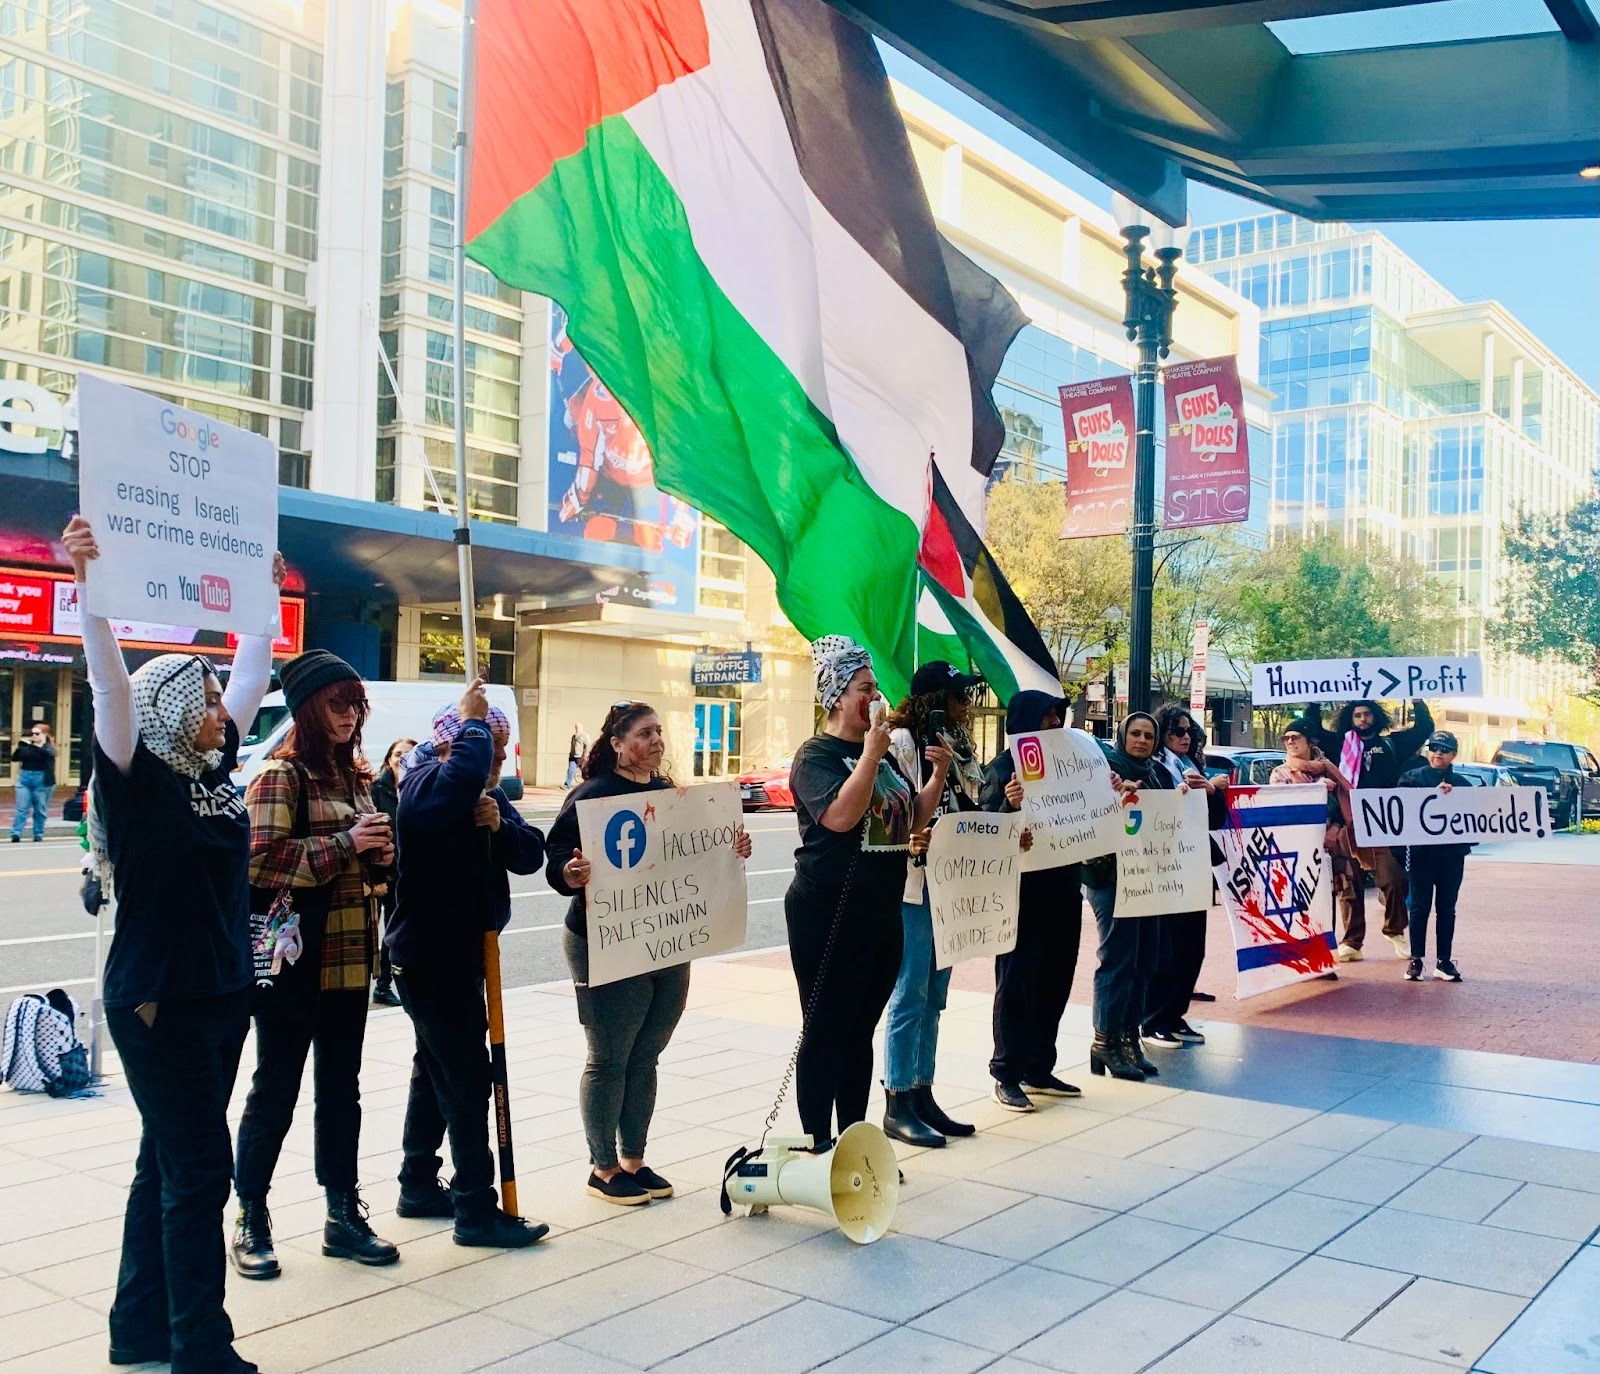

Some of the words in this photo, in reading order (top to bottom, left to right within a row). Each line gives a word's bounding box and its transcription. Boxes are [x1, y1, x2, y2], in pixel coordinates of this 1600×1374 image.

[1166, 371, 1192, 380] THEATRE
[1193, 365, 1223, 376] COMPANY
[1181, 391, 1217, 420] GUYS
[161, 408, 219, 451] Google
[1078, 410, 1111, 438] GUYS
[1194, 424, 1235, 448] DOLLS
[169, 451, 211, 480] STOP
[1091, 441, 1125, 464] DOLLS
[117, 481, 180, 516] erasing
[195, 495, 240, 527] Israeli
[1168, 484, 1247, 523] STC
[107, 512, 141, 536] war
[147, 520, 194, 546] crime
[200, 530, 264, 558] evidence
[147, 580, 168, 600] on
[178, 576, 230, 608] YouTube
[694, 662, 714, 673] BOX
[716, 660, 750, 671] OFFICE
[694, 670, 749, 683] ENTRANCE
[1266, 661, 1373, 698] Humanity
[1408, 665, 1467, 697] Profit
[1053, 752, 1107, 782] Instagram
[1041, 790, 1087, 810] removing
[1361, 795, 1404, 838] NO
[1419, 790, 1546, 839] Genocide!
[967, 821, 1000, 836] Meta
[934, 854, 1018, 885] COMPLICIT
[1226, 826, 1274, 906] ISRAEL
[594, 873, 700, 919] SILENCES
[599, 900, 708, 950] PALESTINIAN
[645, 925, 711, 963] VOICES
